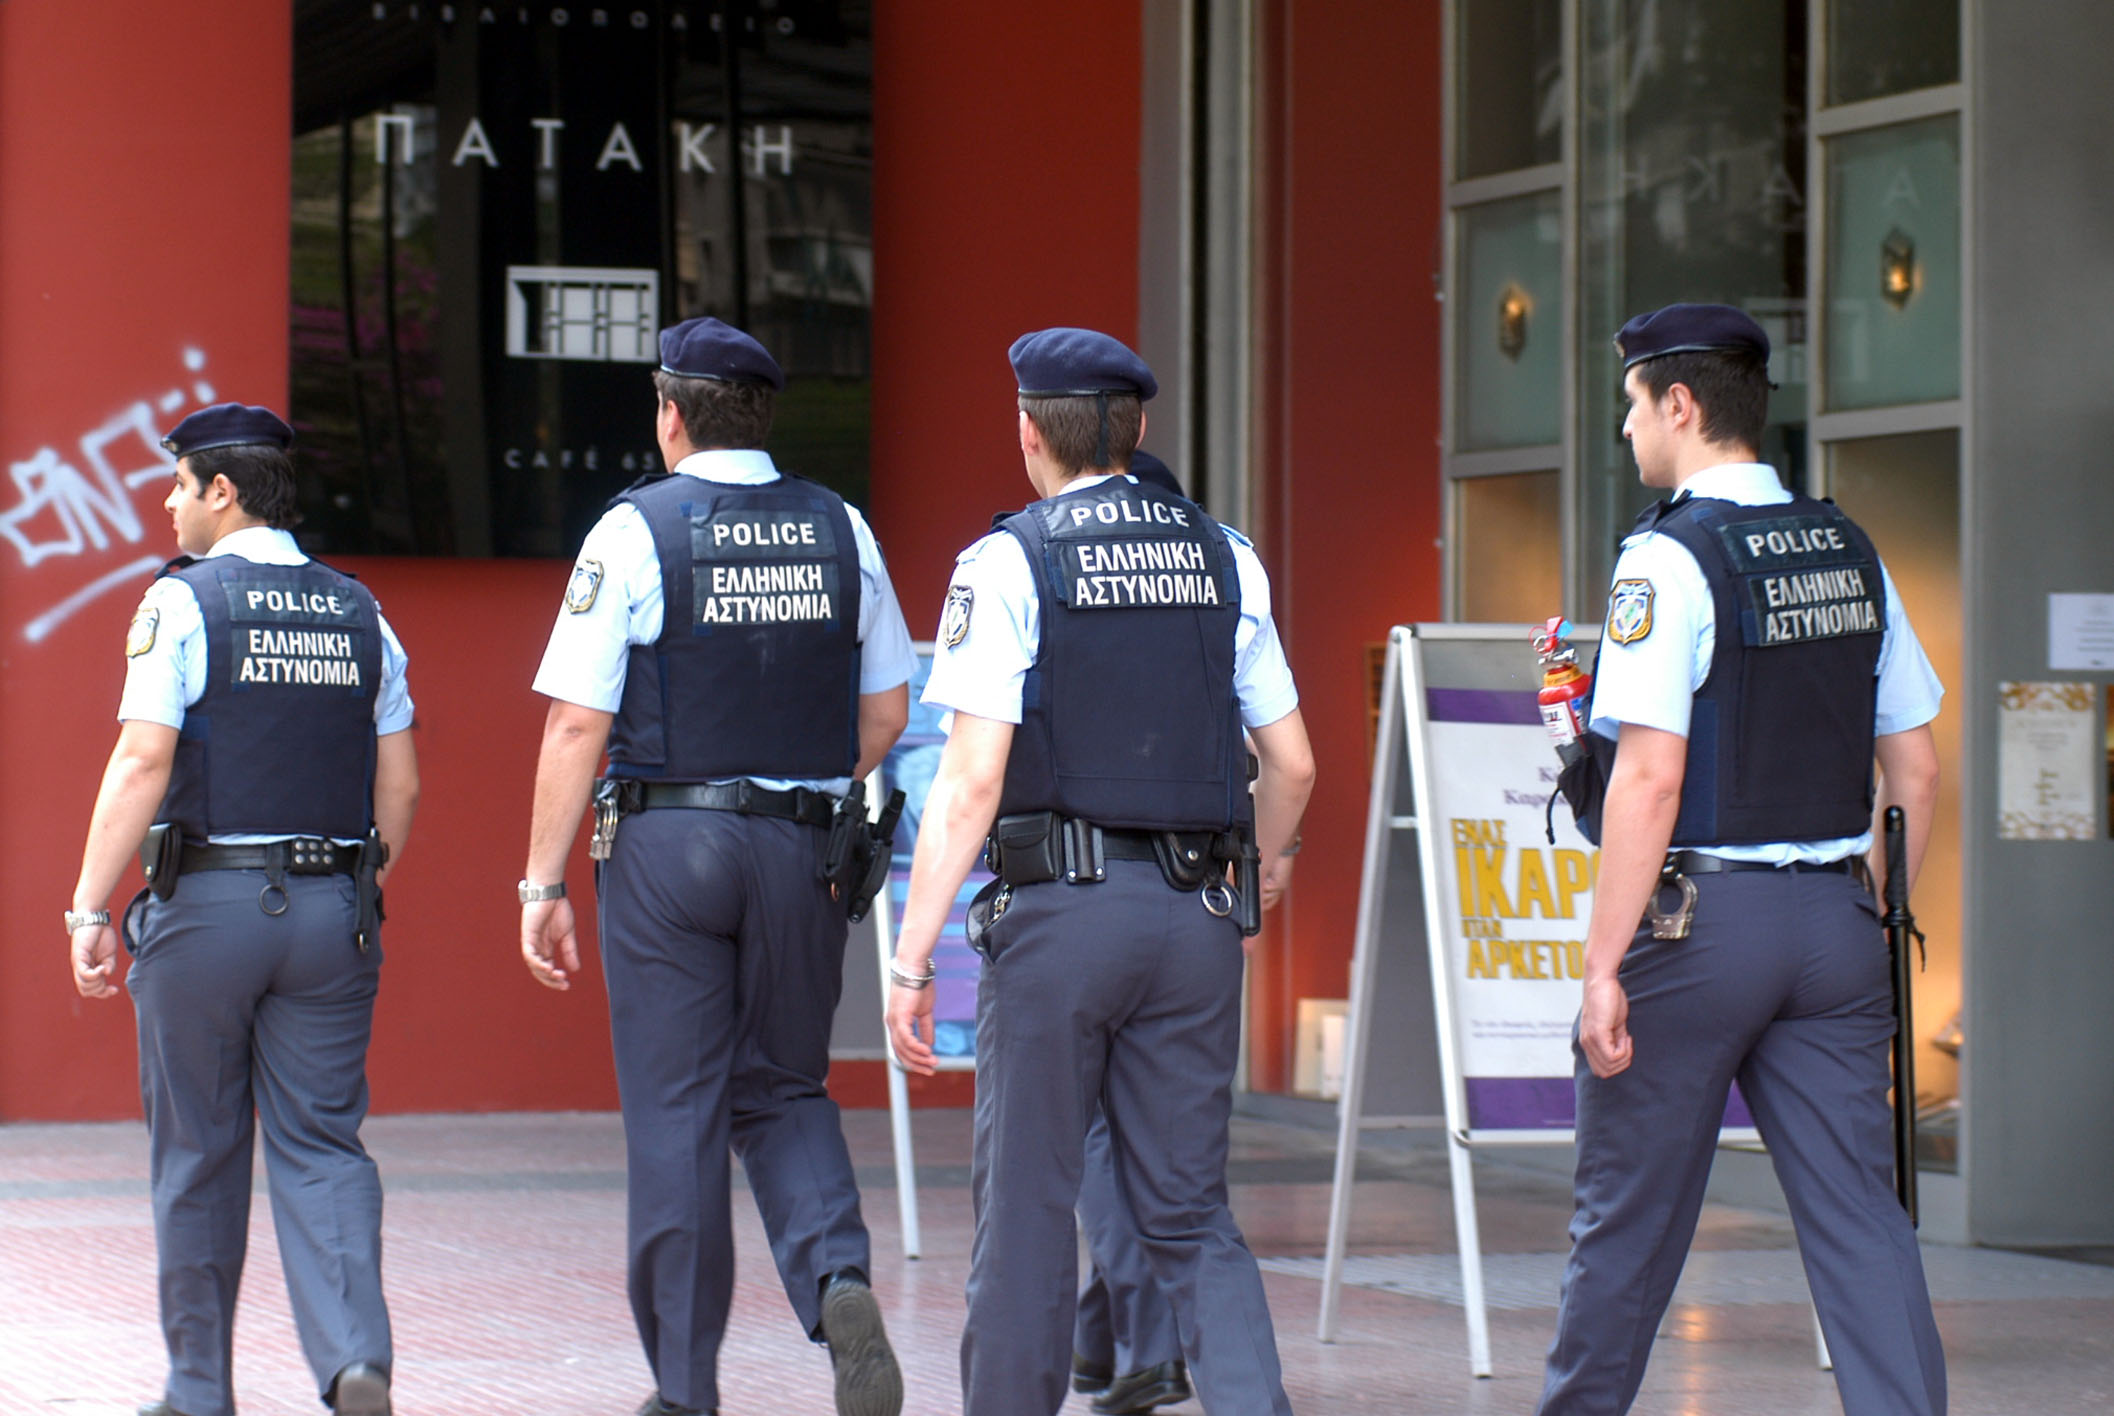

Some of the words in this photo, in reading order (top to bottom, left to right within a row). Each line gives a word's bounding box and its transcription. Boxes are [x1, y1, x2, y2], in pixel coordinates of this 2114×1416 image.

[374, 114, 793, 175] ΠΑΤΑΚΗ
[1070, 500, 1191, 527] POLICE
[713, 523, 816, 546] POLICE
[1745, 527, 1845, 557] POLICE
[1077, 542, 1206, 573] ΕΛΛΗΝΙΚΗ
[713, 565, 823, 593] ΕΛΛΗΝΙΚΗ
[1076, 575, 1218, 606] ΑΣΤΥΝΟΜΙΑ
[1764, 569, 1865, 608] ΕΛΛΗΝΙΚΗ
[247, 590, 344, 615] POLICE
[702, 595, 832, 623] ΑΣΤΥΝΟΜΙΑ
[1766, 601, 1879, 643] ΑΣΤΥΝΟΜΙΑ
[249, 630, 351, 658] ΕΛΛΗΝΙΚΗ
[240, 657, 361, 686] ΑΣΤΥΝΟΜΙΑ
[1456, 847, 1602, 919] ΙΚΑΡ
